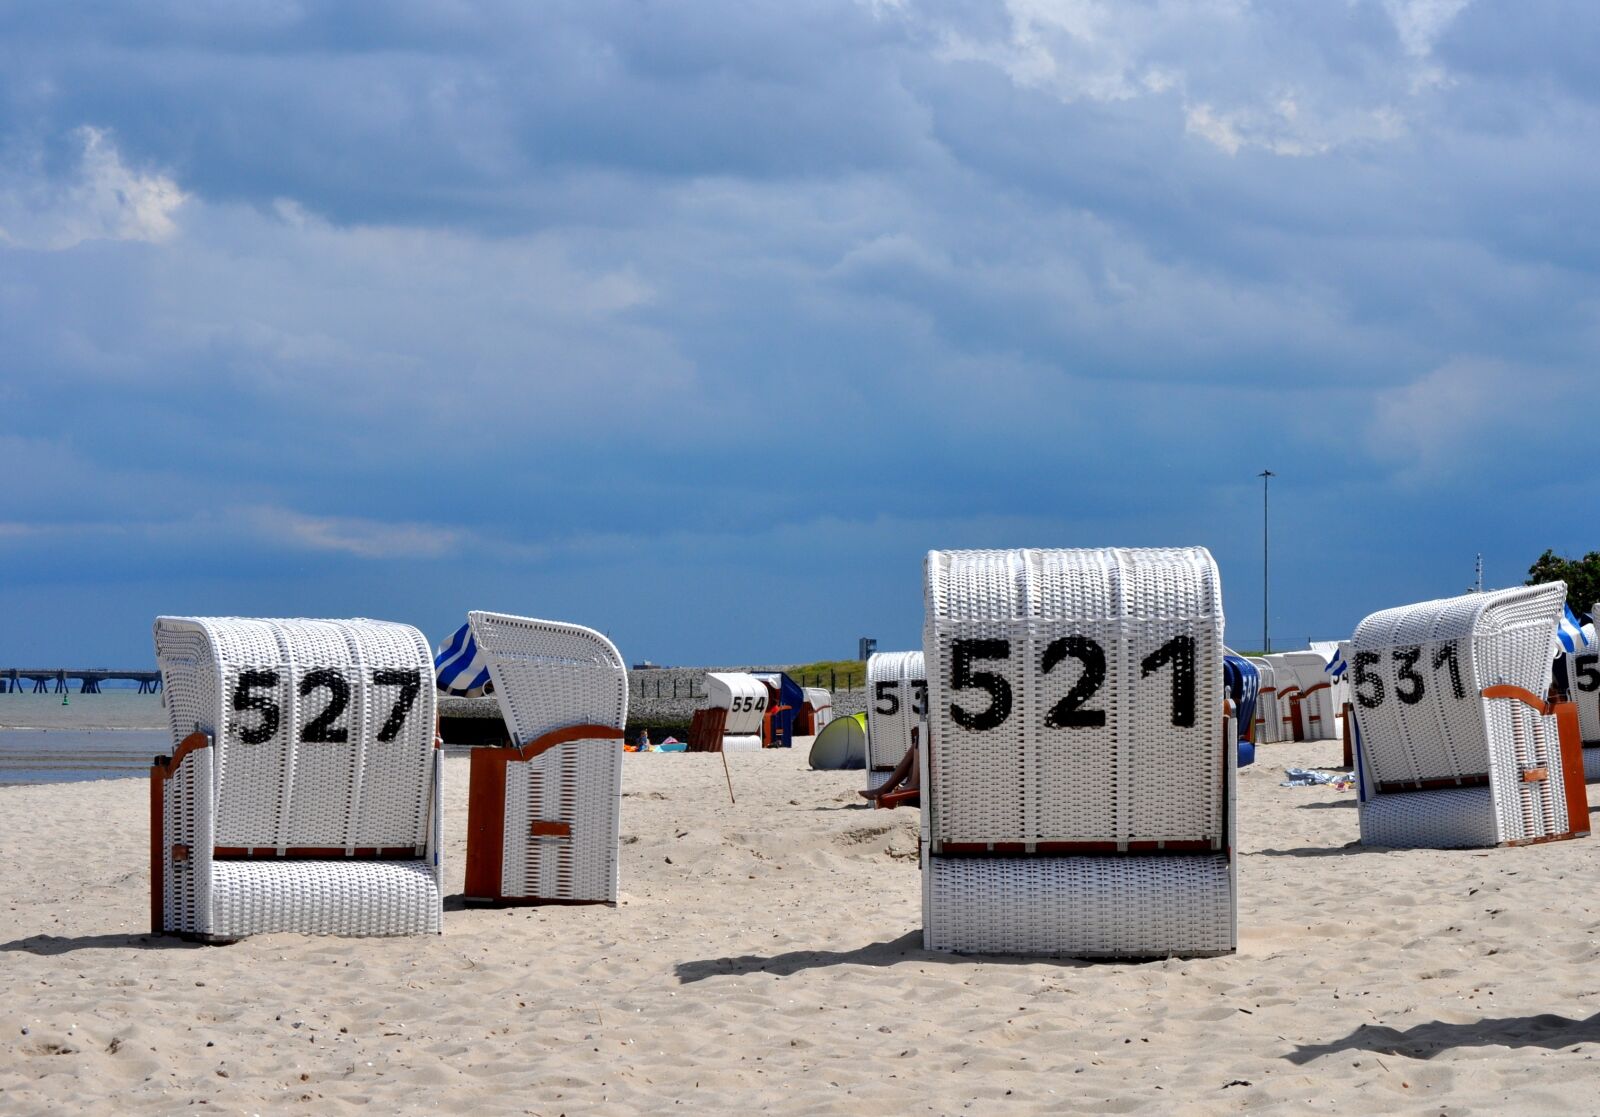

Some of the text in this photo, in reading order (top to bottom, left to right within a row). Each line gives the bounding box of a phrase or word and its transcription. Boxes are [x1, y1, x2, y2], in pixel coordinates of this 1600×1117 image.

[231, 668, 421, 744] 527
[731, 696, 765, 712] 554
[951, 635, 1195, 730] 521
[1353, 640, 1466, 708] 531
